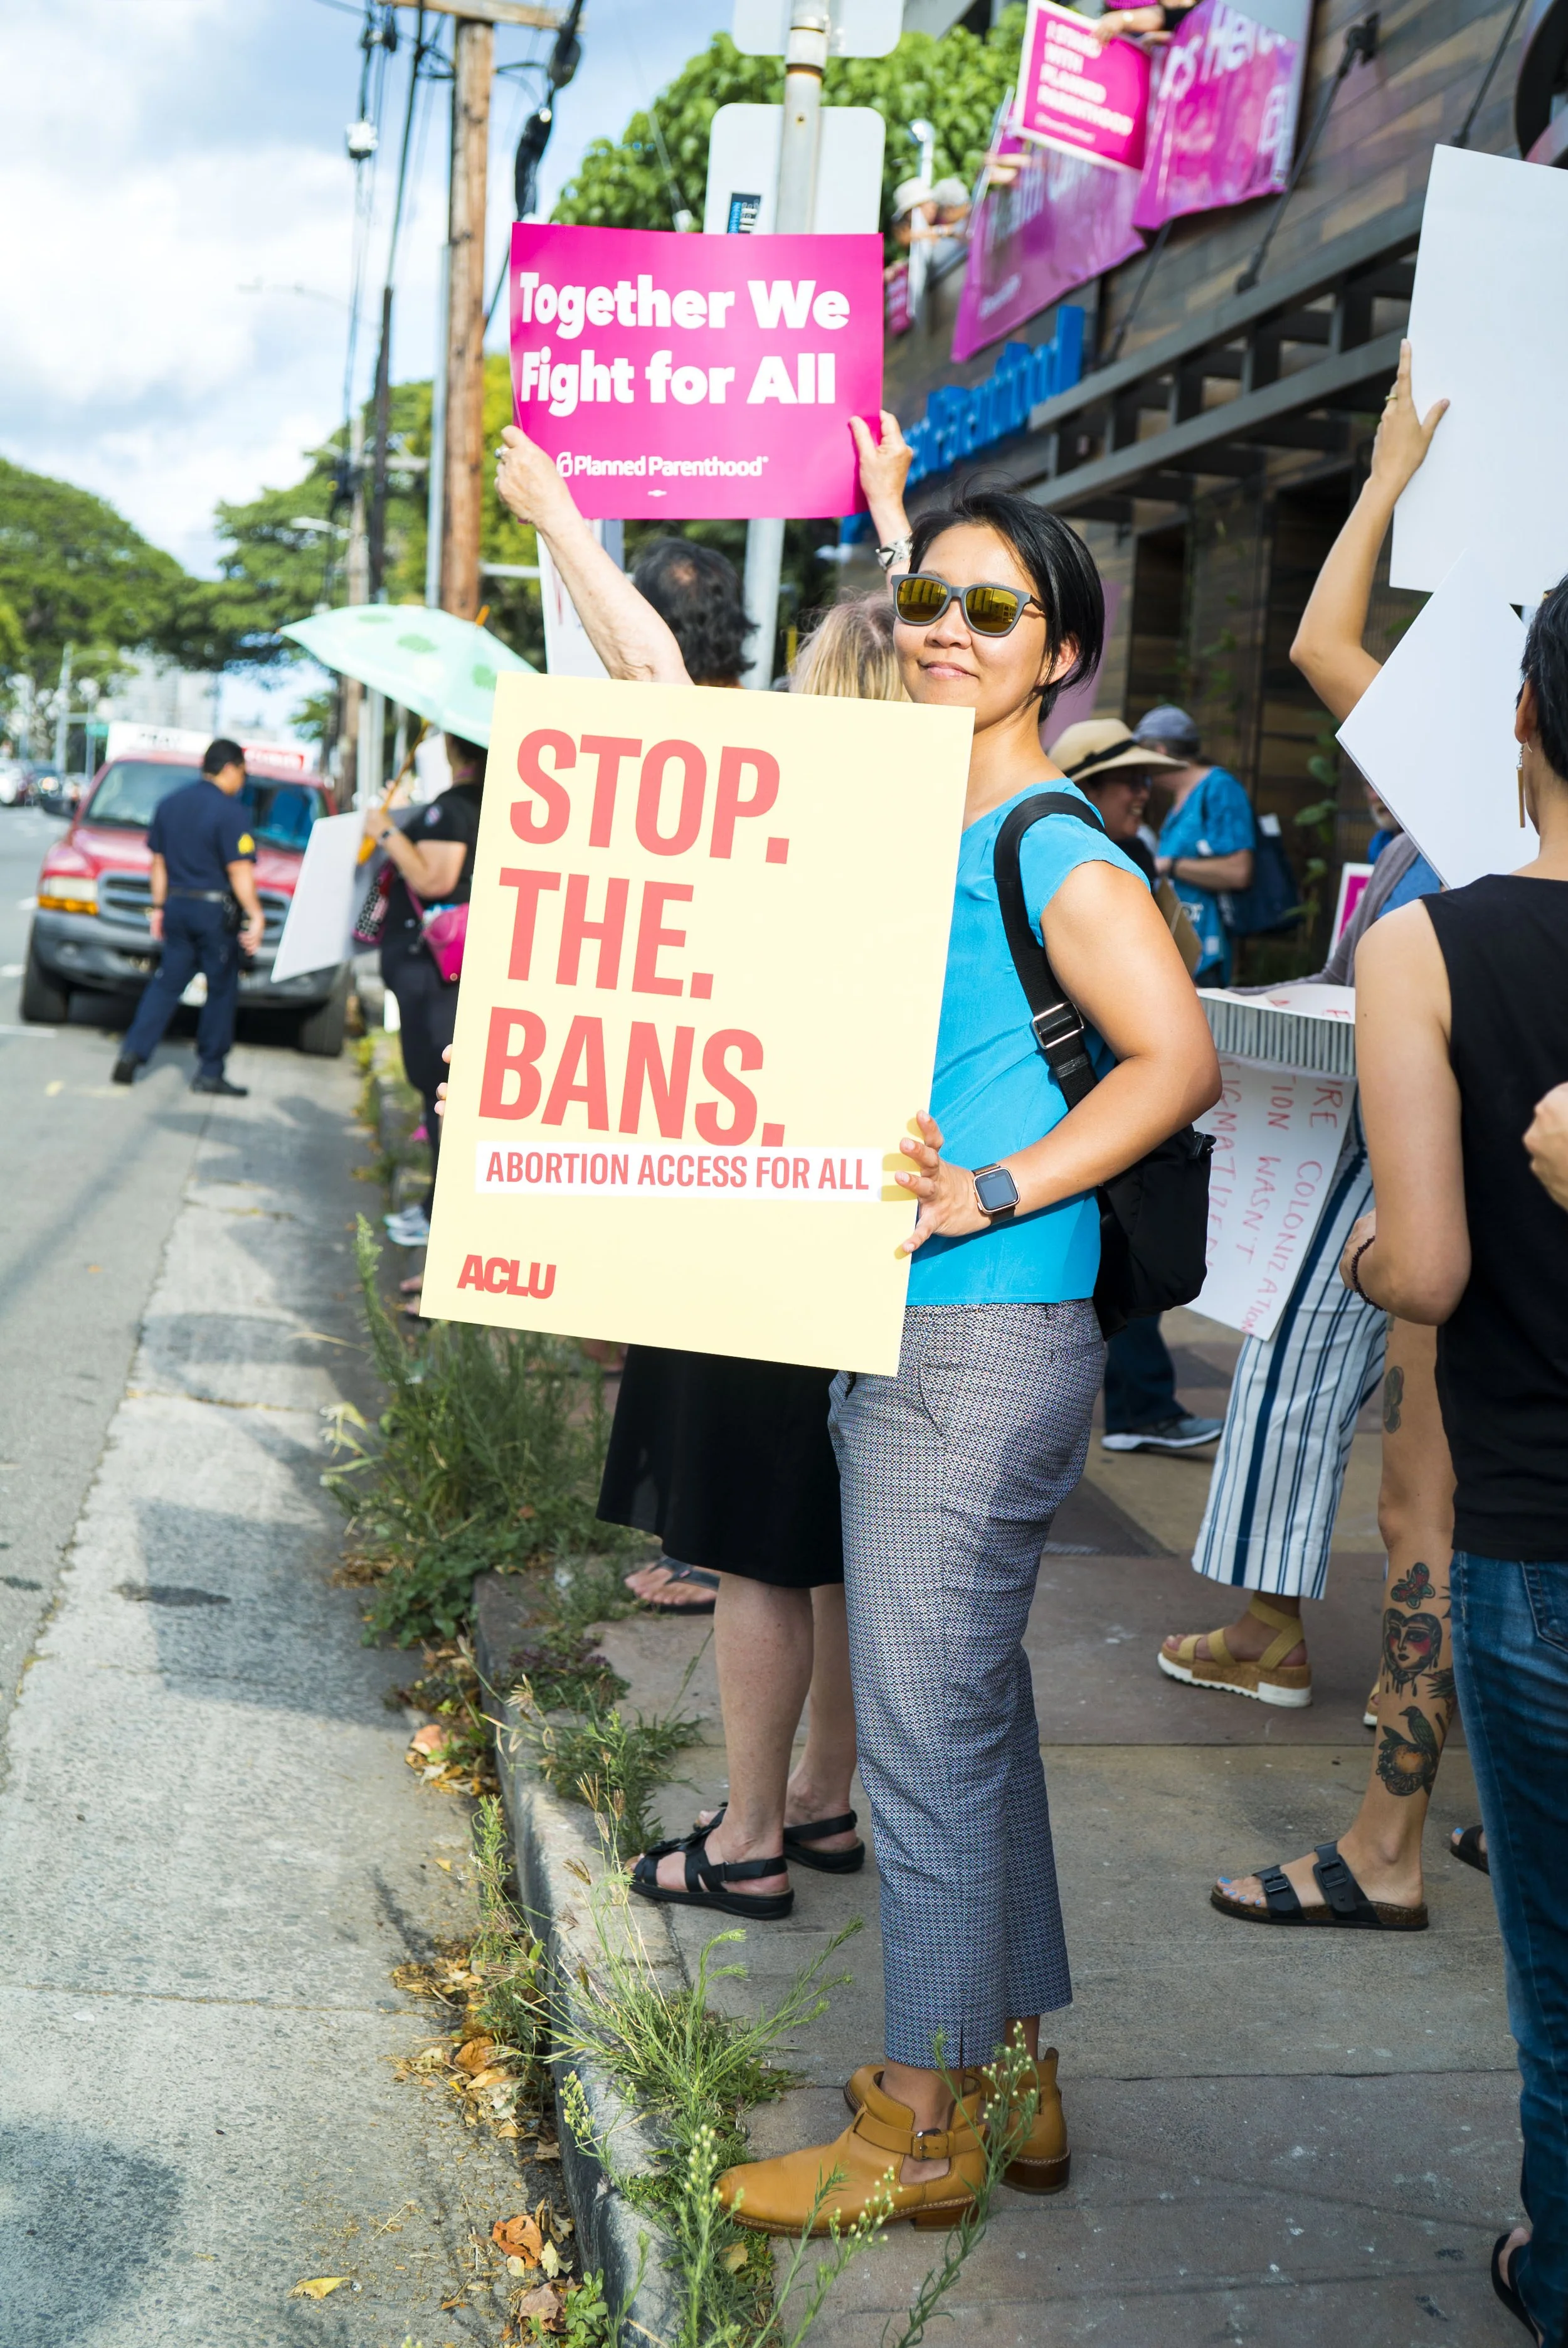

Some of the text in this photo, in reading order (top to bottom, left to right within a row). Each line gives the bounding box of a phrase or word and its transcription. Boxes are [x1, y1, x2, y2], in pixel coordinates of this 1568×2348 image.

[520, 272, 735, 339] Together
[747, 280, 850, 330] We
[521, 346, 835, 417] Fight for All
[574, 455, 763, 477] Planned Parenthood
[510, 729, 789, 864] STOP.
[499, 868, 713, 1000] THE.
[479, 1006, 785, 1147] BANS.
[486, 1152, 869, 1190] ABORTION ACCESS FOR ALL
[457, 1254, 556, 1299] ACLU
[1241, 1161, 1323, 1336] COLONIZATION
